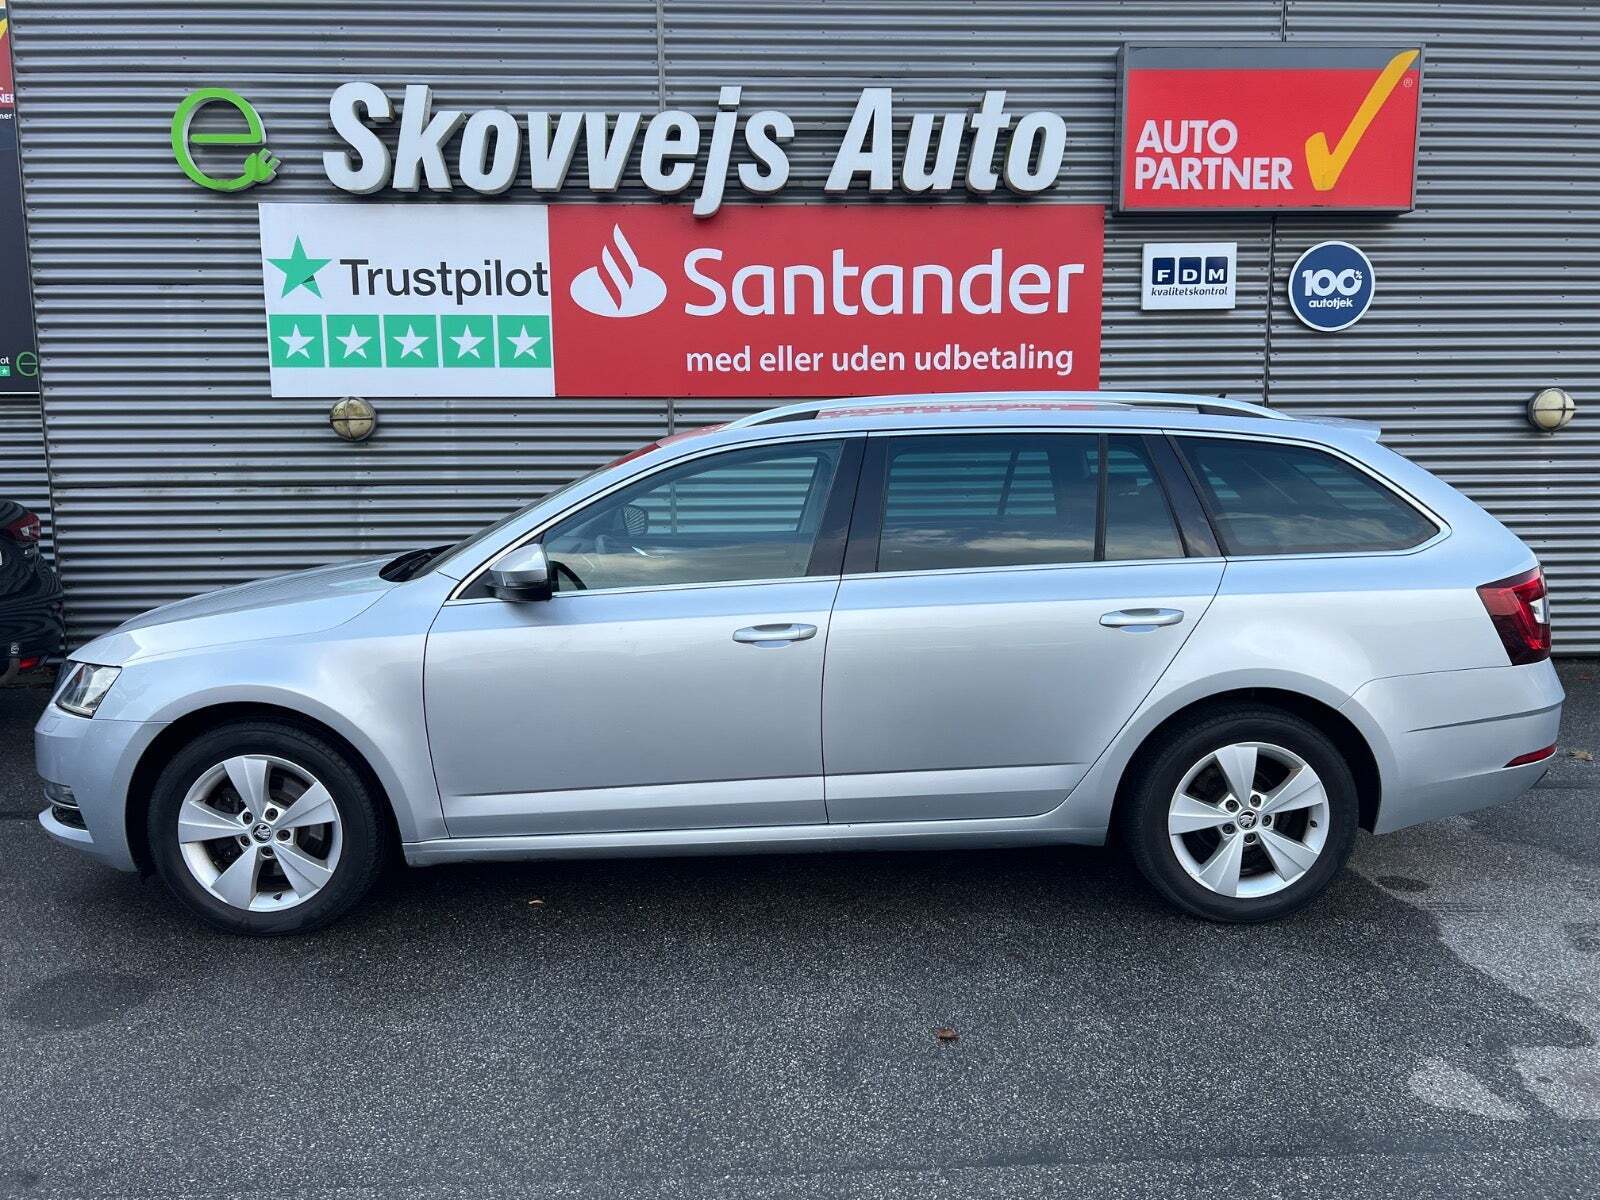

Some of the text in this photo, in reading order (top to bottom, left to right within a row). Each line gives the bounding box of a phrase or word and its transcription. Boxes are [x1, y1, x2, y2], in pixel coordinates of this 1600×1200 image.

[322, 82, 1068, 218] Skovvejs Auto
[1135, 119, 1238, 154] AUTO
[1134, 156, 1295, 190] PARTNER
[339, 258, 549, 306] Trustpilot
[683, 247, 1085, 316] Santander
[1151, 286, 1228, 296] kvalitetskontrol
[1156, 266, 1225, 283] FDM
[1308, 297, 1353, 310] autotjek
[686, 343, 1073, 376] med eller uden udbetaling
